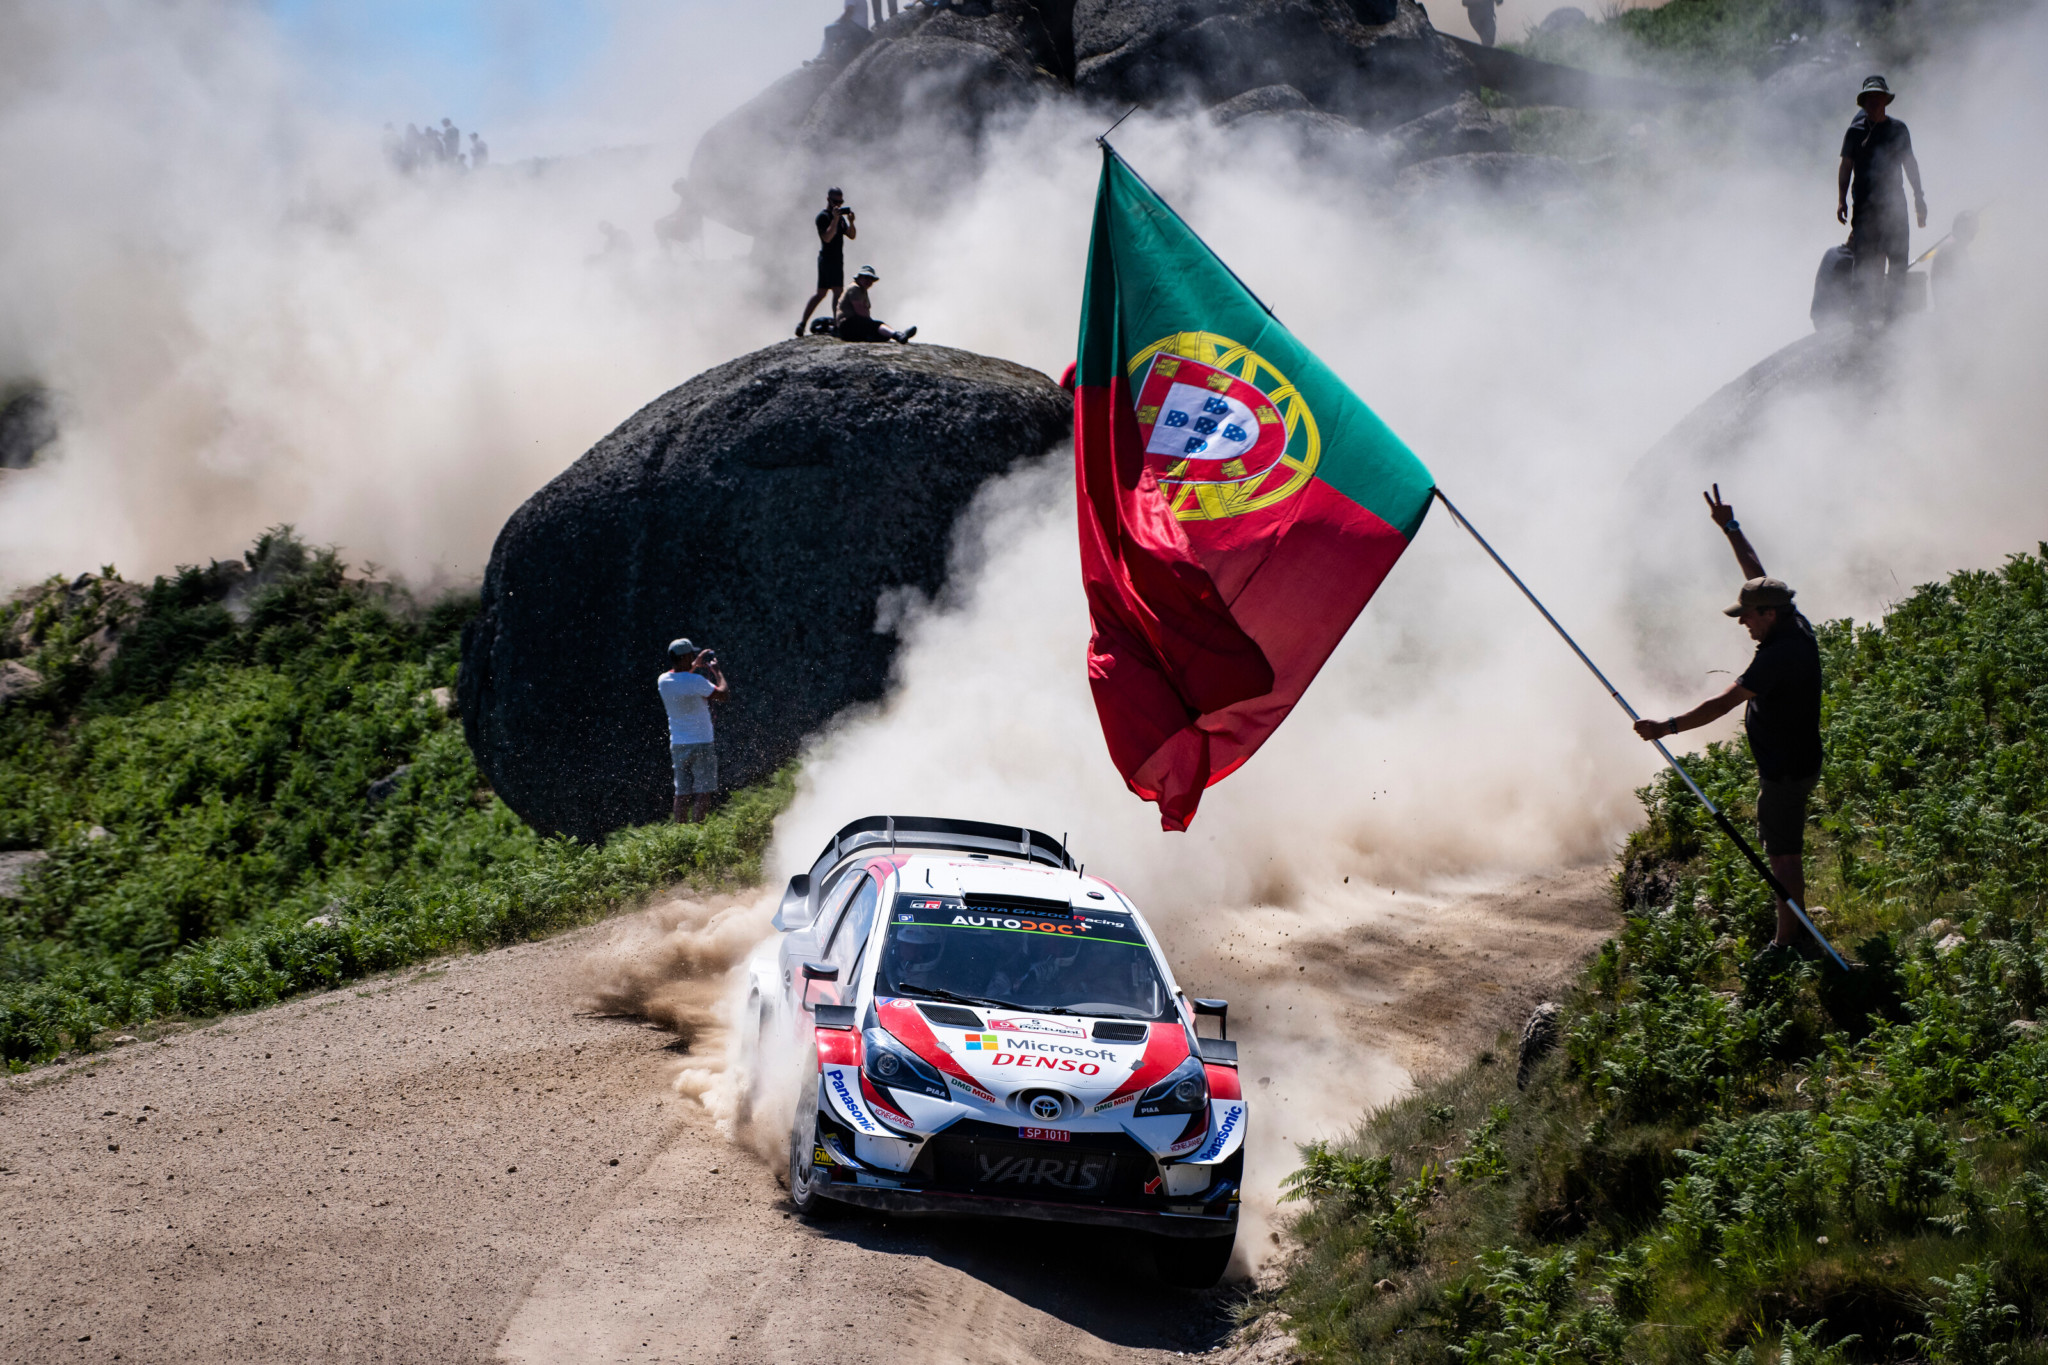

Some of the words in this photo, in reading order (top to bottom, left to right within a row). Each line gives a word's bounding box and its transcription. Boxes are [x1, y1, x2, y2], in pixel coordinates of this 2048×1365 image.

[1013, 908, 1069, 919] GAZOO
[1073, 915, 1125, 928] Racing
[1019, 1024, 1080, 1035] Portugal
[1007, 1038, 1117, 1062] Microsoft
[992, 1053, 1100, 1076] DENSO
[827, 1069, 876, 1132] Panasonic
[925, 1086, 946, 1098] PIAA
[950, 1078, 972, 1092] DMG
[971, 1088, 996, 1103] MORI
[1094, 1103, 1113, 1113] DMG
[1113, 1094, 1135, 1107] MORI
[875, 1107, 915, 1129] KONECRANES
[1026, 1128, 1042, 1139] SP
[1045, 1129, 1068, 1141] 1011
[1200, 1105, 1243, 1161] Panasonic
